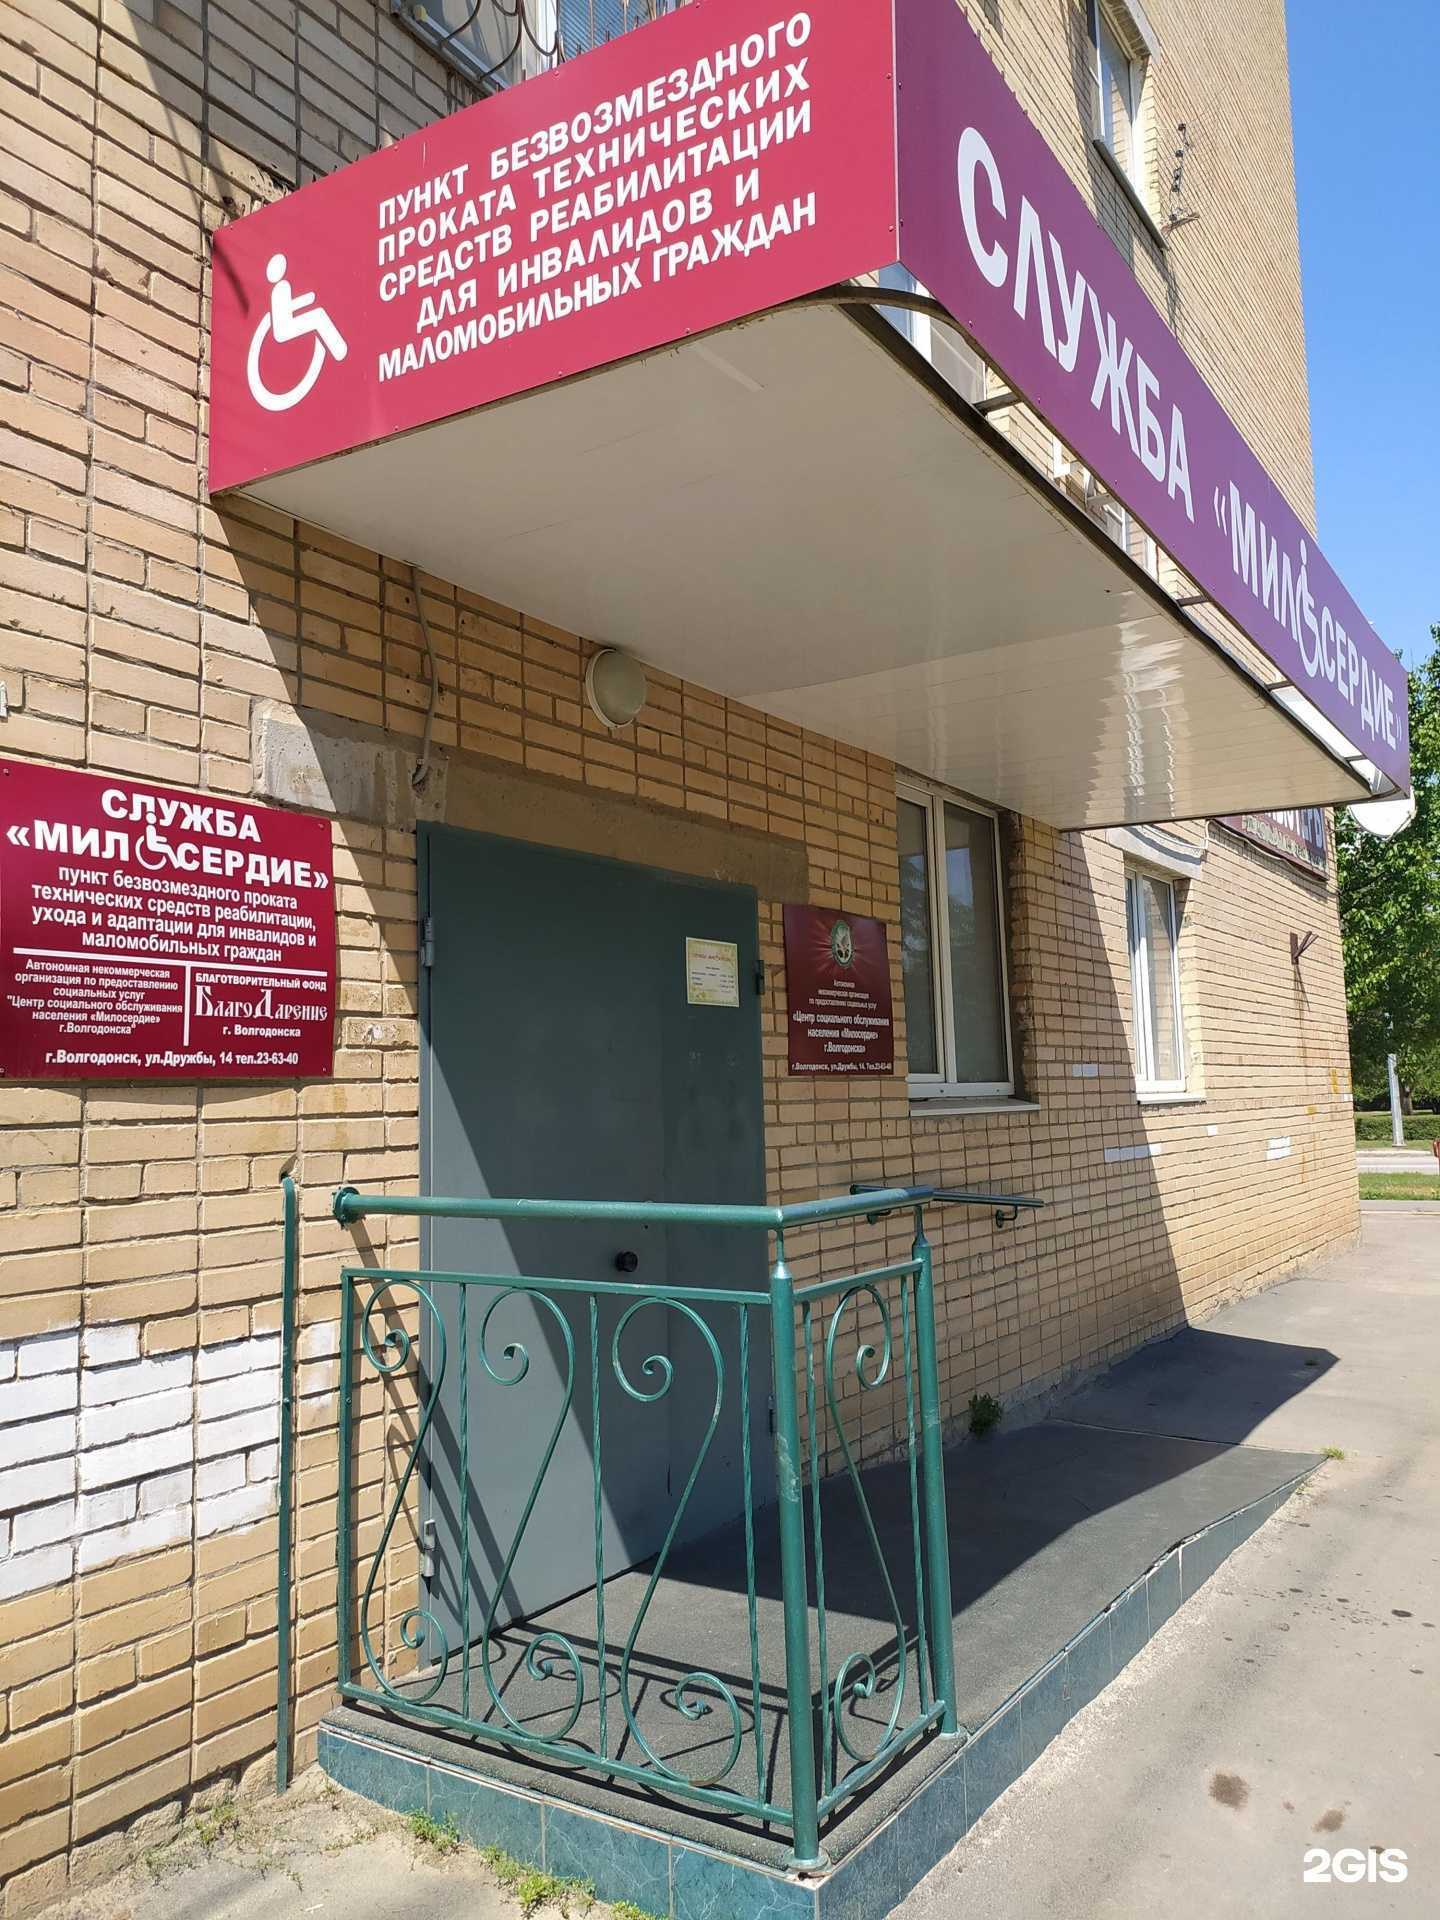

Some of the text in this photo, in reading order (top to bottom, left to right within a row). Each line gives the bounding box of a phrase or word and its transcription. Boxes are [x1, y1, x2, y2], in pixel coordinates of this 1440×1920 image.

[378, 12, 812, 229] ПУНКТ БЕЗВОЗМЕЗДНОГО
[377, 58, 811, 266] ПРОКАТА ТЕХНИЧЕСКИХ
[379, 100, 812, 302] СРЕДСТВ РЕАБИЛИТАЦИИ
[416, 168, 760, 331] ДЛЯ ИНВАЛИДОВ И
[378, 192, 817, 383] МАЛОМОБИЛЬНЫХ ГРАЖДАН
[957, 126, 1194, 524] СЛУЖБА
[101, 788, 262, 842] СЛУЖБА
[32, 884, 316, 931] технических средств реабилитации,
[58, 866, 298, 909] пункт безвозмездного проката
[32, 905, 317, 947] ухода и адаптации для инвалидов и
[82, 932, 282, 962] маломобильных граждан
[15, 973, 179, 991] организация по предоставлению
[25, 958, 171, 979] Автономная некоммерческая
[195, 972, 327, 992] БЛАГОТВОРИТЕЛЬНЫЙ ФОНД
[47, 998, 114, 1010] социального
[115, 1000, 183, 1014] обслуживания
[53, 986, 146, 1002] социальных услуг
[32, 1010, 161, 1025] населения «Милосердие»
[222, 1024, 301, 1037] г. Волгодонска
[145, 1050, 216, 1068] ул.Дружбы,
[219, 1052, 233, 1065] 14
[235, 1051, 299, 1065] тел.23-63-40
